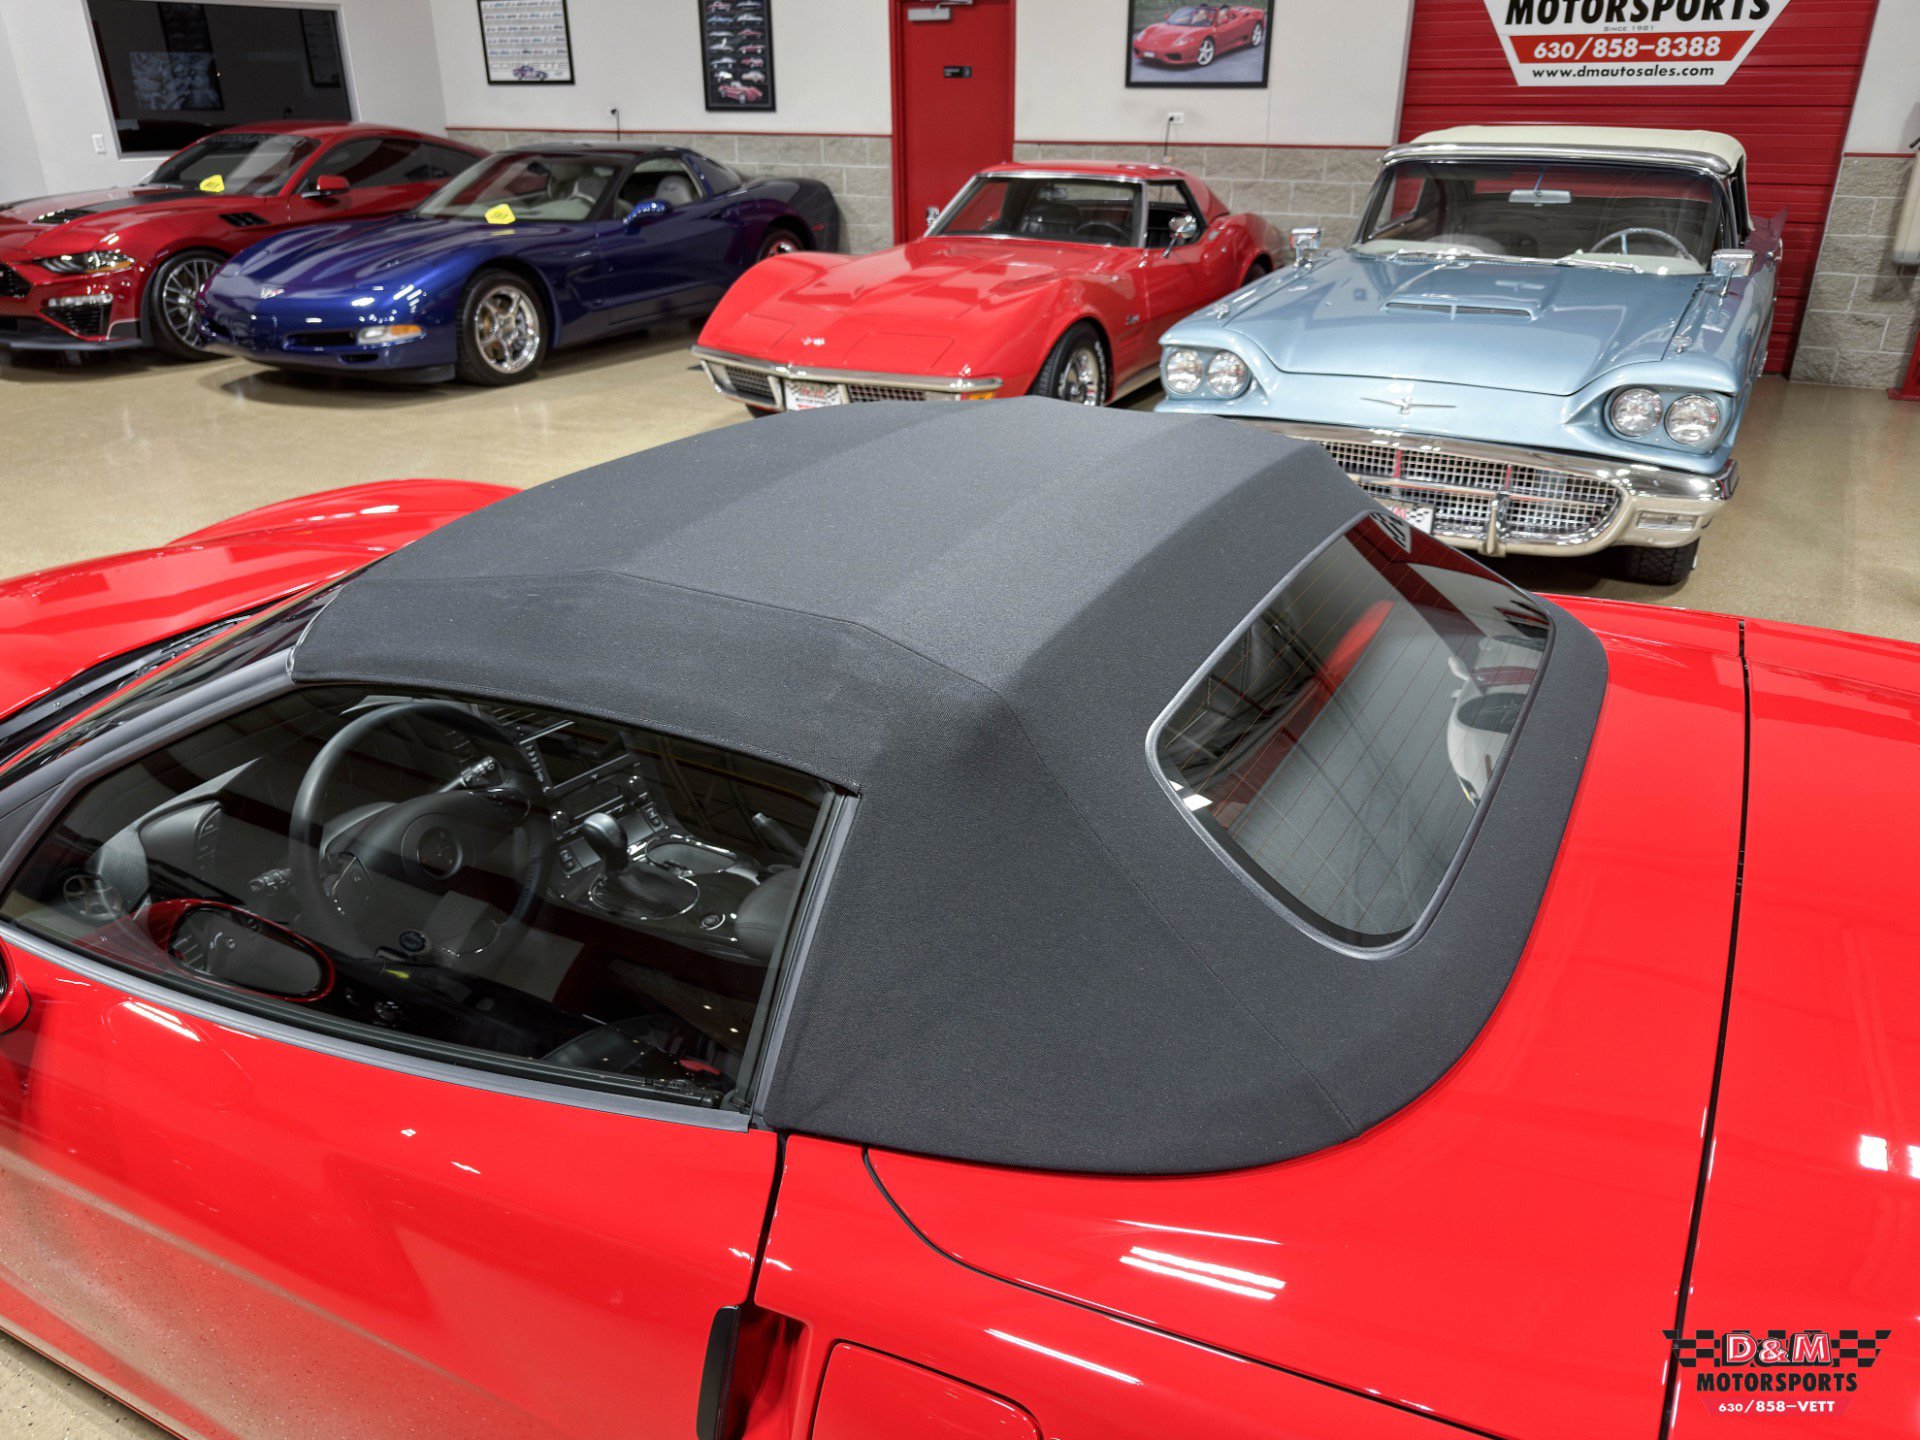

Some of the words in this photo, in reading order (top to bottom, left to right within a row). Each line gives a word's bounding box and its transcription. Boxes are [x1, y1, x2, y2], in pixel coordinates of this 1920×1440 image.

[1505, 0, 1770, 24] MOTORSPORTS
[1533, 36, 1720, 60] 630/858-8388
[1532, 64, 1714, 78] www.dmautosales.com
